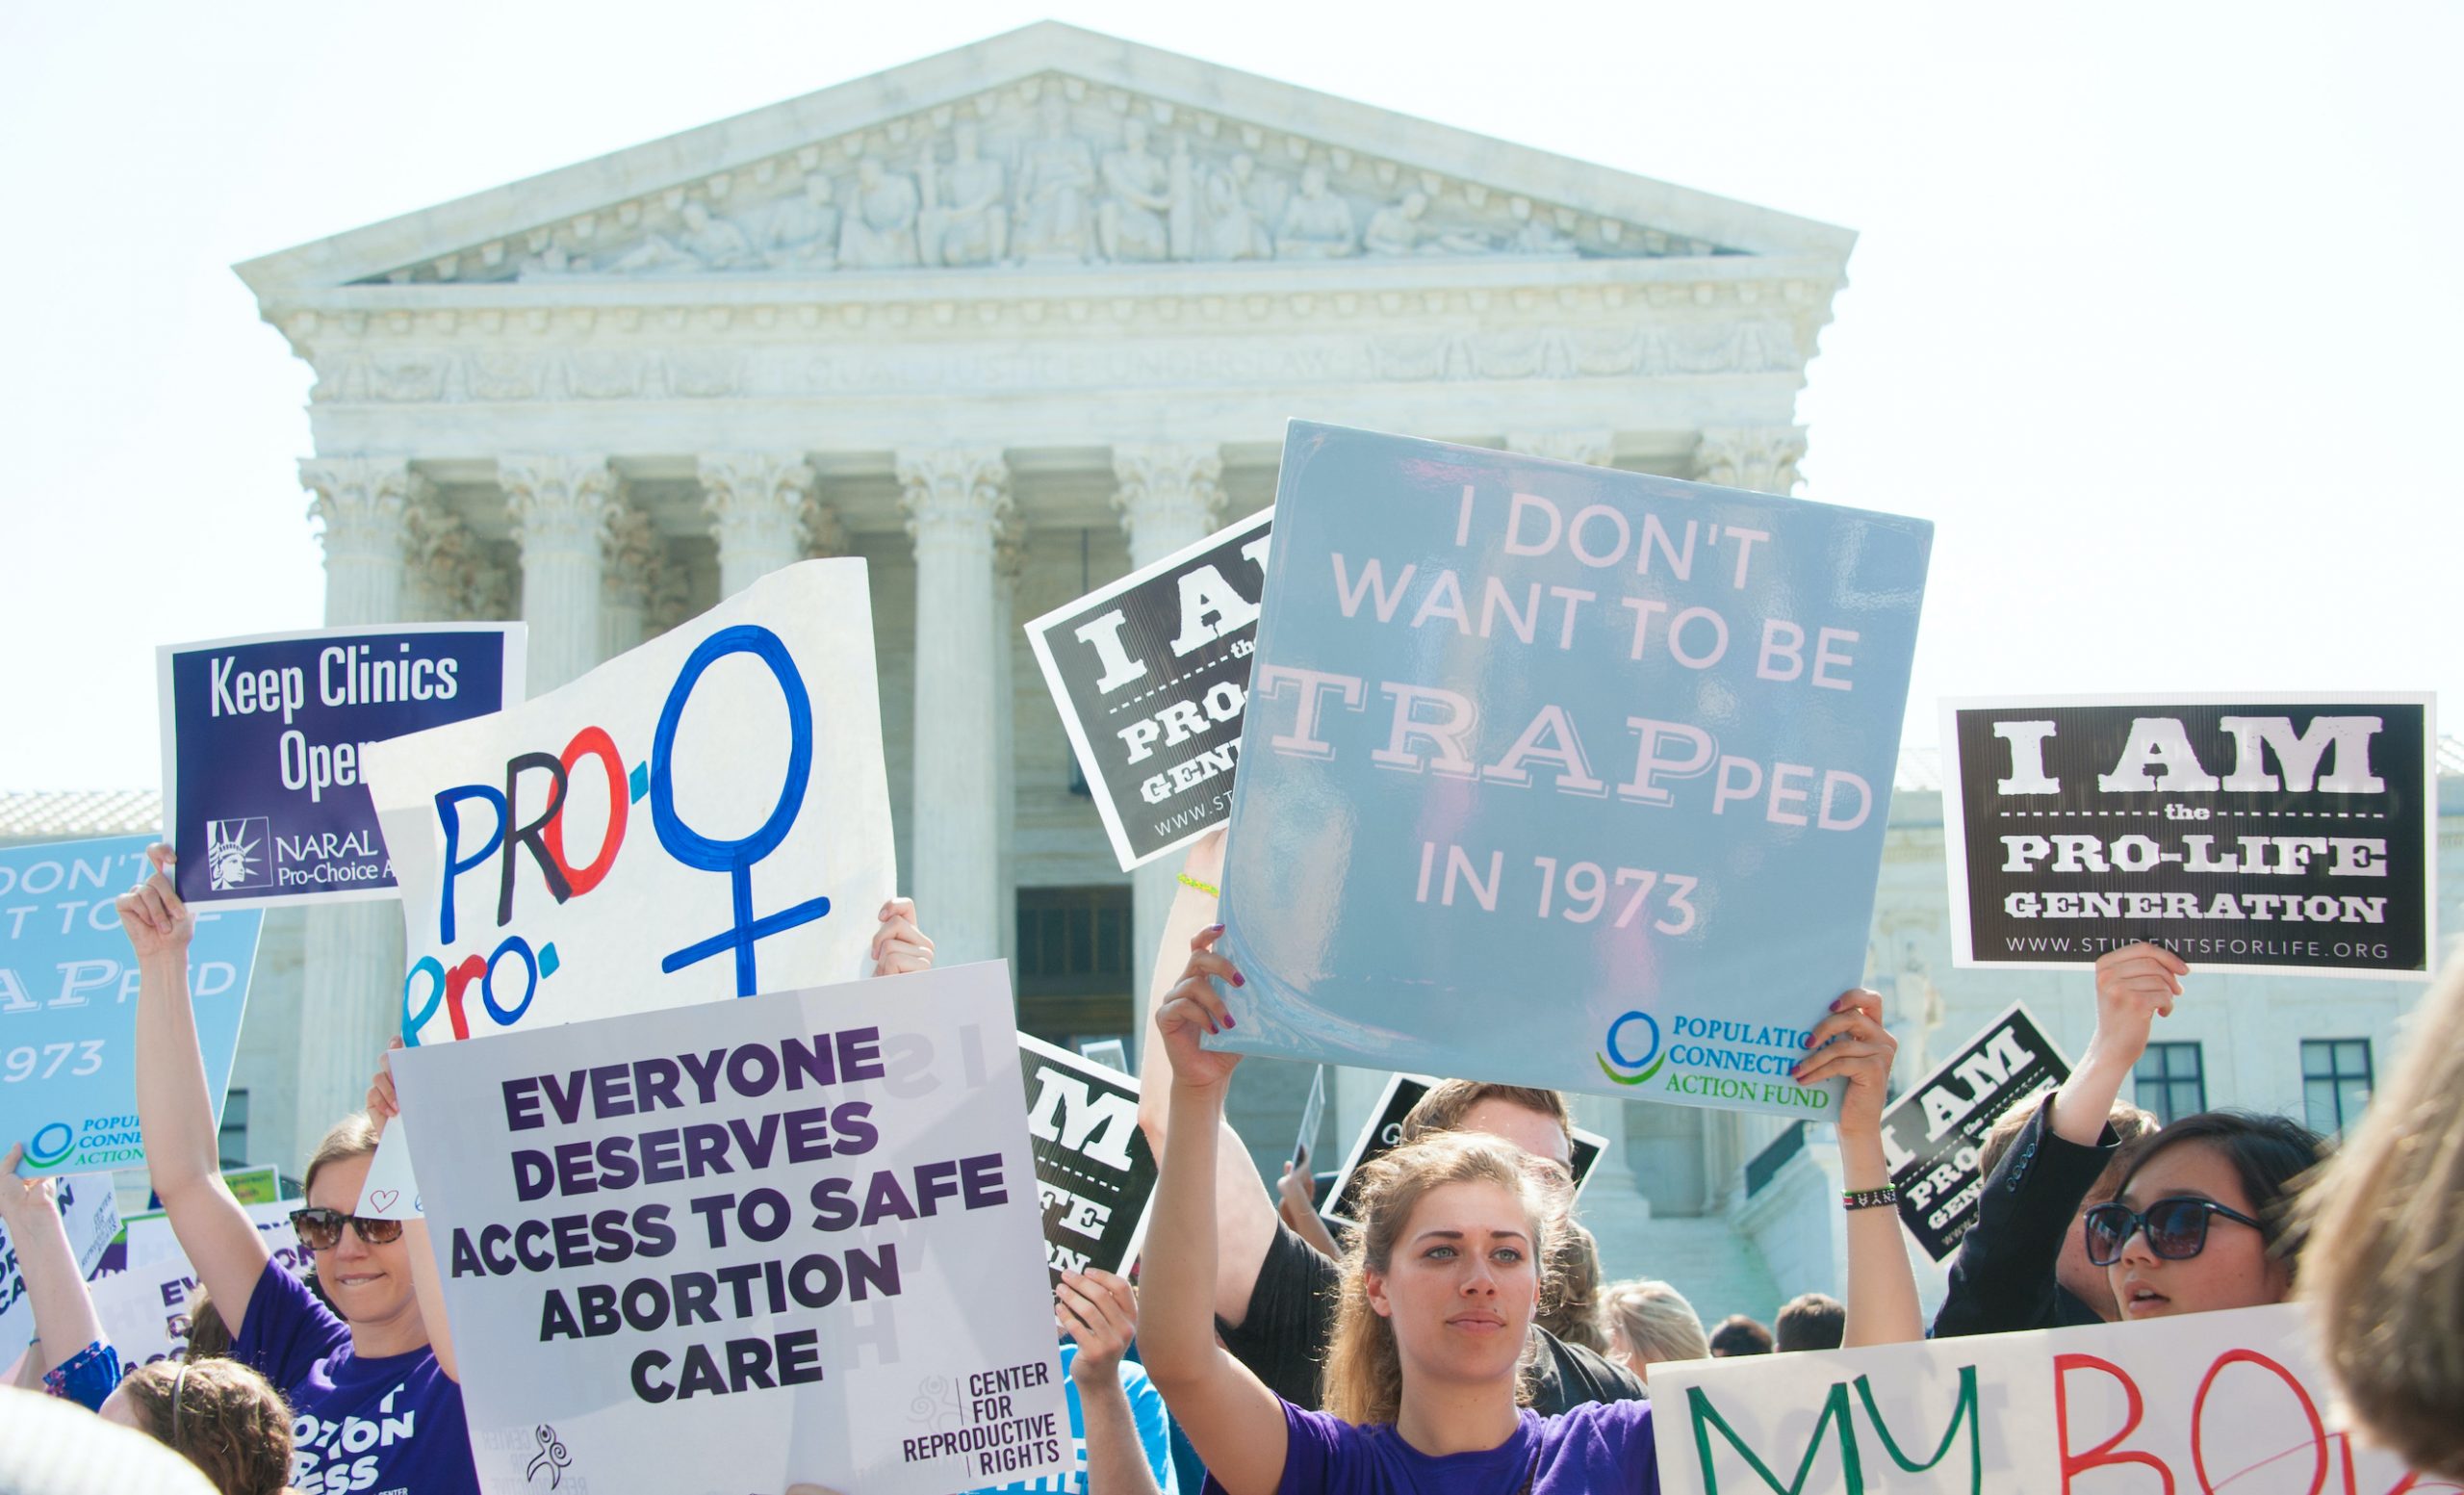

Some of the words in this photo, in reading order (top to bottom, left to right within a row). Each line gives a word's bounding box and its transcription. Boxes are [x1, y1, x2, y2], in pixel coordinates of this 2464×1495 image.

[1453, 484, 1475, 547] I
[1503, 493, 1770, 590] DON'T
[1074, 608, 1148, 695] I
[1329, 552, 1597, 652] WANT
[1621, 596, 1730, 671] TO
[1755, 618, 1861, 691] BE
[211, 656, 305, 724] Keep
[320, 643, 458, 708] Clinics
[1116, 681, 1249, 765] PRO
[1256, 663, 1873, 833] TRAPPED
[1993, 720, 2061, 796] I
[2097, 716, 2387, 794] AM
[1140, 735, 1242, 805] GEN
[275, 830, 379, 863] NARAL
[1154, 789, 1233, 838] WWW.ST
[2165, 803, 2211, 821] the
[278, 862, 379, 886] Pro-Choice
[1416, 840, 1503, 913] IN
[1533, 856, 1699, 938] 1973
[2000, 834, 2388, 877] PRO-LIFE
[2004, 891, 2388, 925] GENERATION
[0, 1039, 106, 1083] 973
[1669, 1044, 1803, 1077] CONNECTI
[1672, 1016, 1837, 1051] POPULATIO
[500, 1026, 886, 1131] EVERYONE
[1665, 1072, 1758, 1101] ACTION
[1763, 1085, 1829, 1109] FUND
[1920, 1024, 2036, 1143] AM
[511, 1101, 880, 1202] DESERVES
[1027, 1066, 1140, 1172] M
[75, 1148, 144, 1165] ACTION
[450, 1201, 677, 1278] ACCESS
[691, 1185, 792, 1250] TO
[810, 1152, 1009, 1232] SAFE
[539, 1243, 903, 1342] ABORTION
[630, 1329, 824, 1405] CARE
[969, 1361, 1049, 1397] CENTER
[903, 1412, 1058, 1463] REPRODUCTIVE
[972, 1395, 1014, 1424] FOR
[1686, 1365, 1983, 1495] MY
[980, 1439, 1060, 1476] RIGHTS
